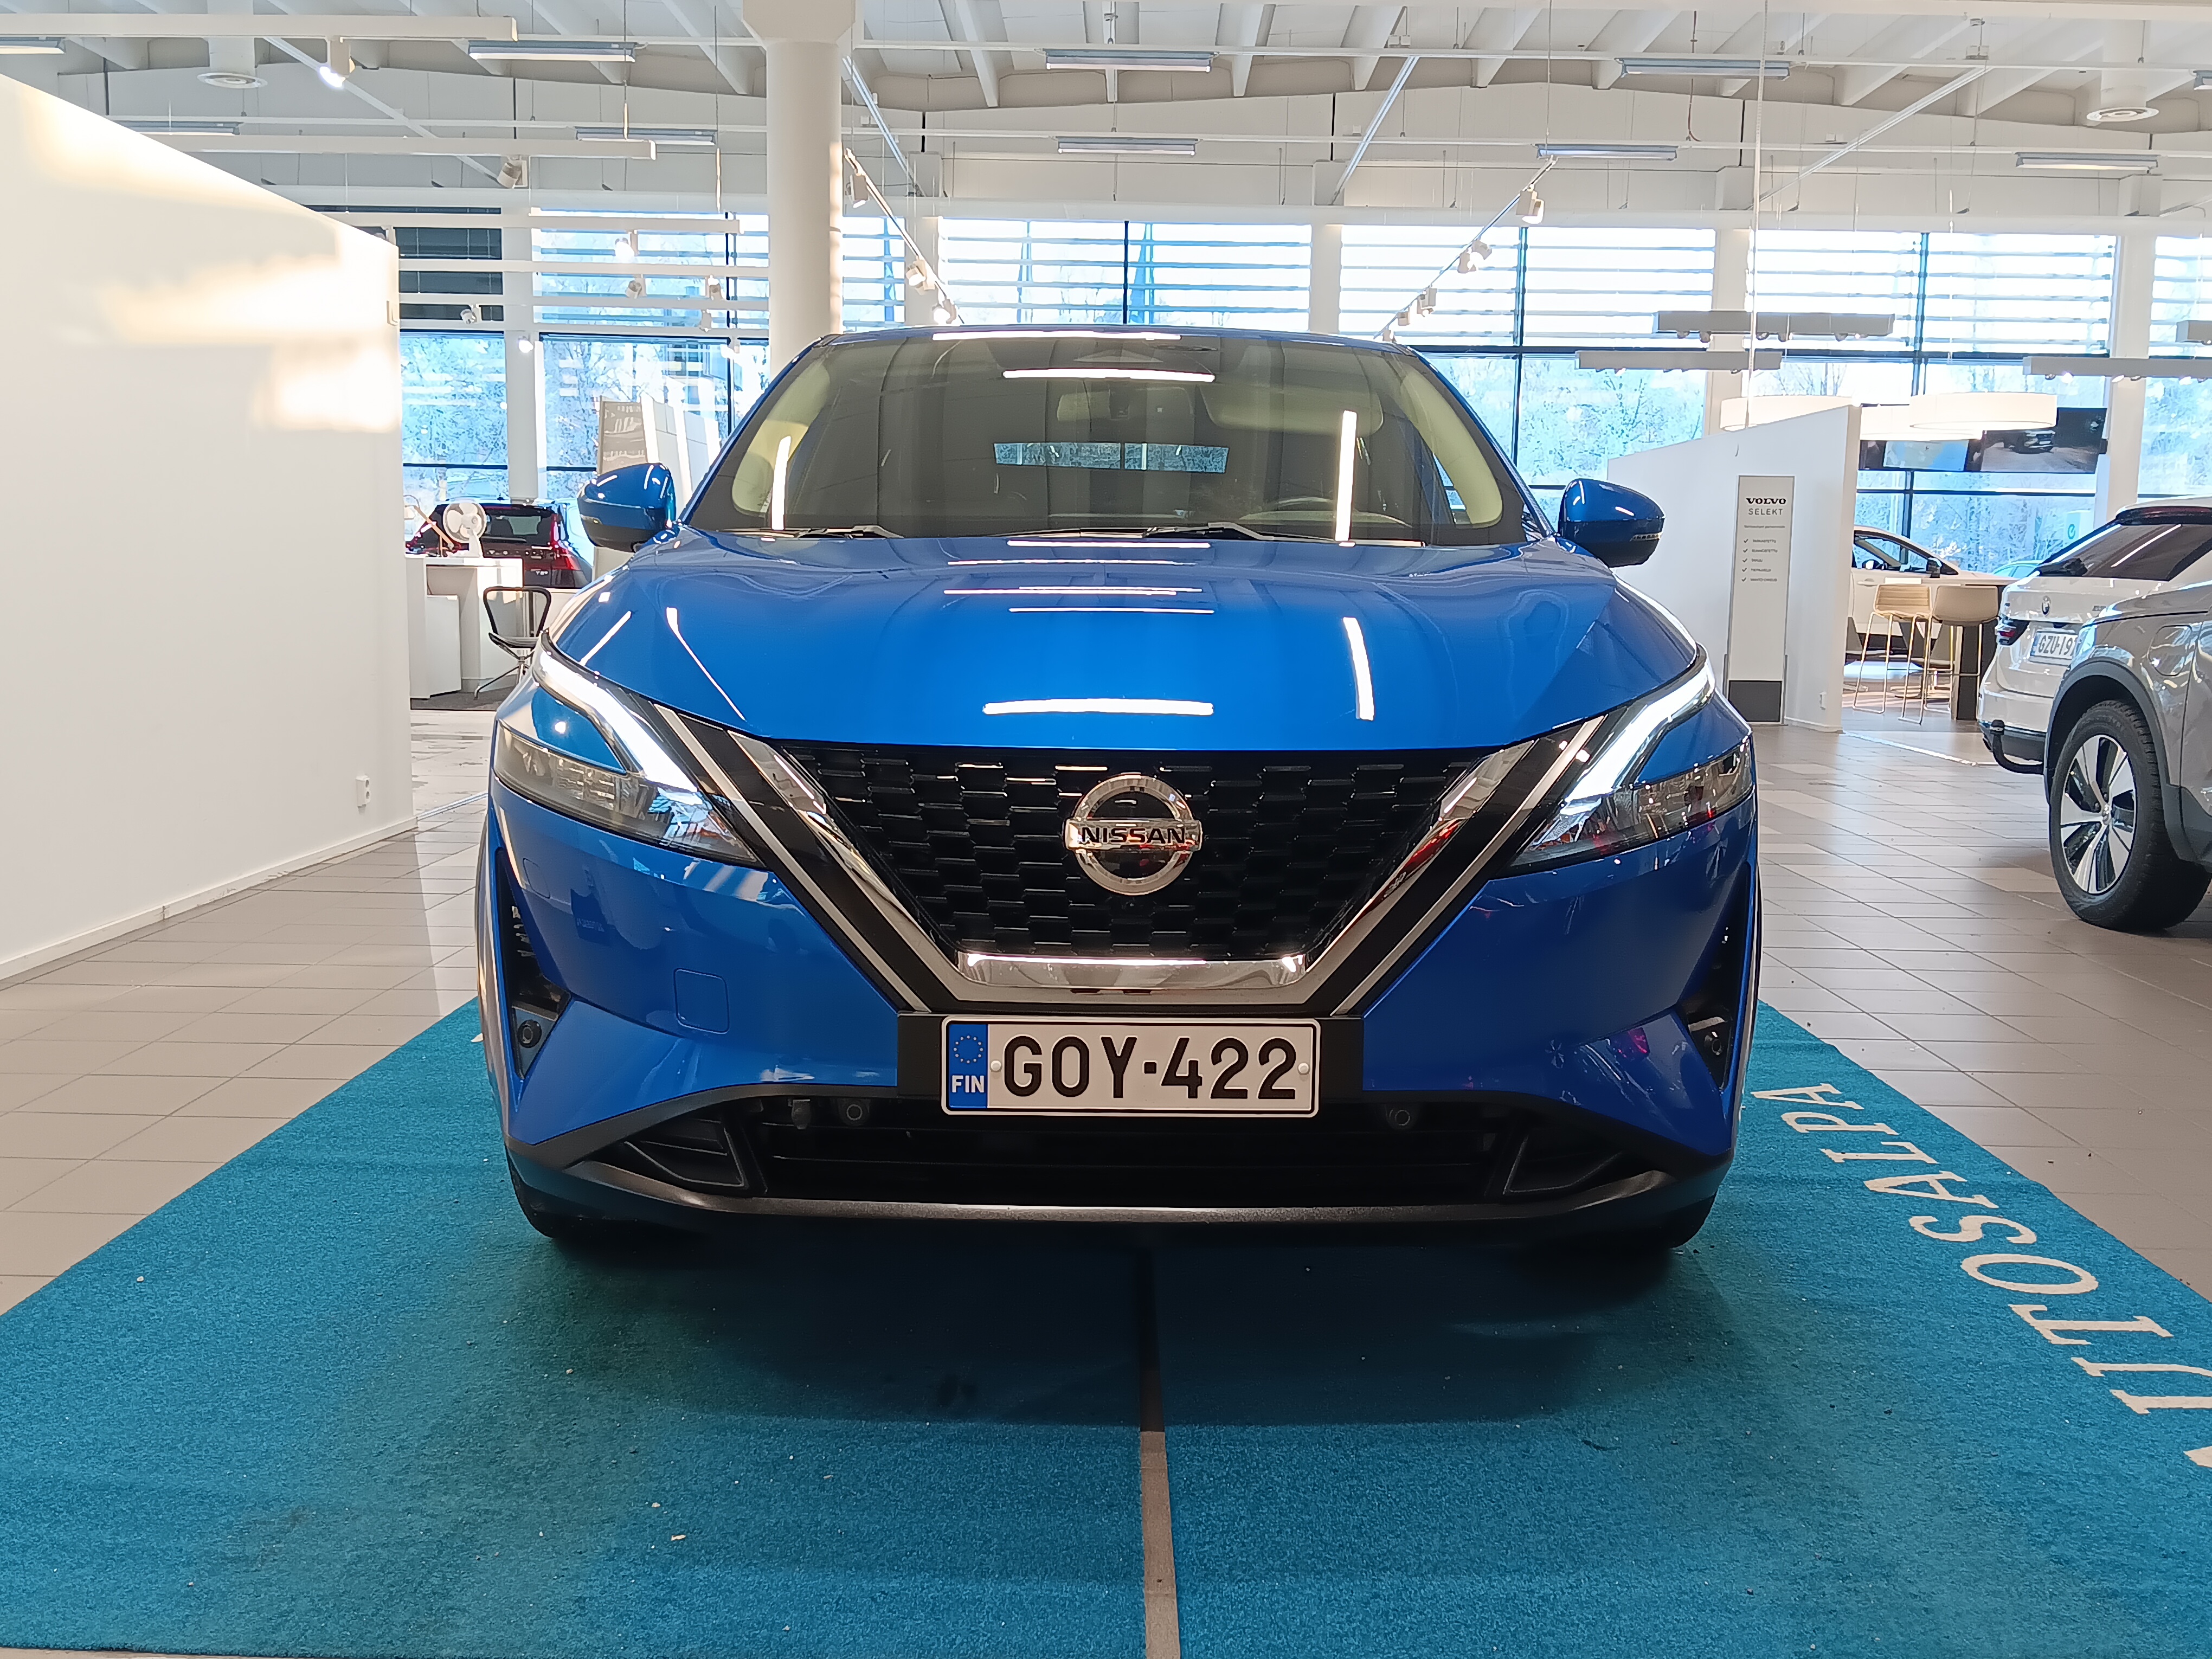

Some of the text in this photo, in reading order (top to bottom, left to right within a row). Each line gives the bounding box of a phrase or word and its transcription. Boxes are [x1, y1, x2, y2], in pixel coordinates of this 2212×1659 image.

[2038, 635, 2076, 655] GZU-19
[1081, 827, 1186, 844] NISSAN
[952, 1036, 1296, 1099] FIN GOY-422
[1751, 1083, 2212, 1468] UTOSALPA
